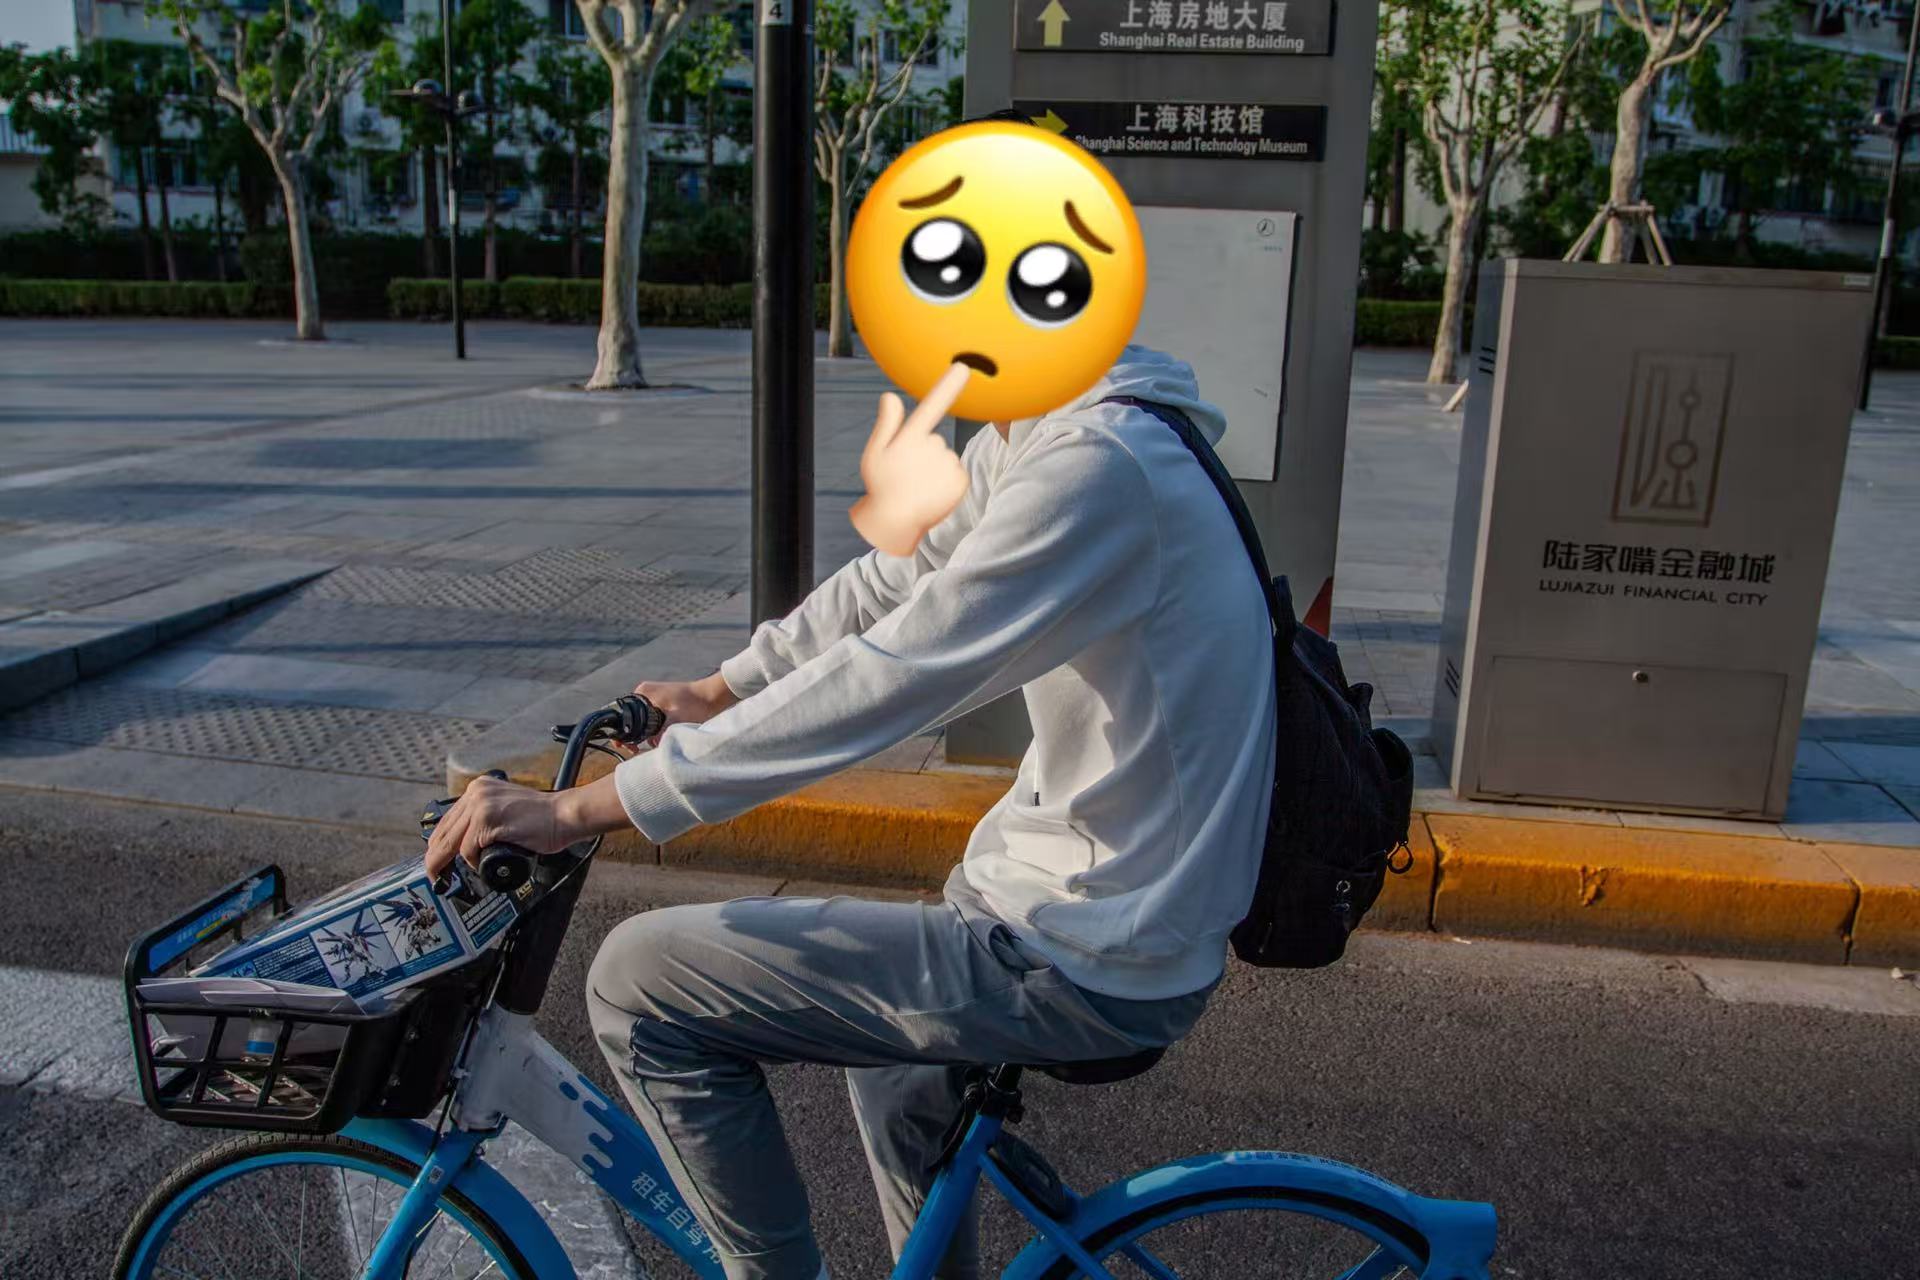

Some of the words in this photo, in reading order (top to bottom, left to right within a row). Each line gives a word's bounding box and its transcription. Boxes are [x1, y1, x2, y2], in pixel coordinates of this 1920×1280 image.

[769, 3, 782, 19] 4
[1119, 0, 1288, 31] 上海房地大厦
[1100, 32, 1164, 49] Shanghai
[1167, 33, 1197, 48] Real
[1200, 33, 1244, 49] Estate
[1247, 34, 1304, 52] Building
[1126, 104, 1265, 135] 上海科技馆
[1127, 136, 1168, 151] Science
[1170, 138, 1192, 151] and
[1193, 137, 1256, 156] Technology
[1259, 139, 1308, 154] Museum
[1543, 540, 1776, 584] 陆家嘴金融城
[1539, 579, 1615, 596] LUJIAZUI
[1623, 584, 1718, 604] FINANCIAL
[1726, 591, 1769, 607] CITY
